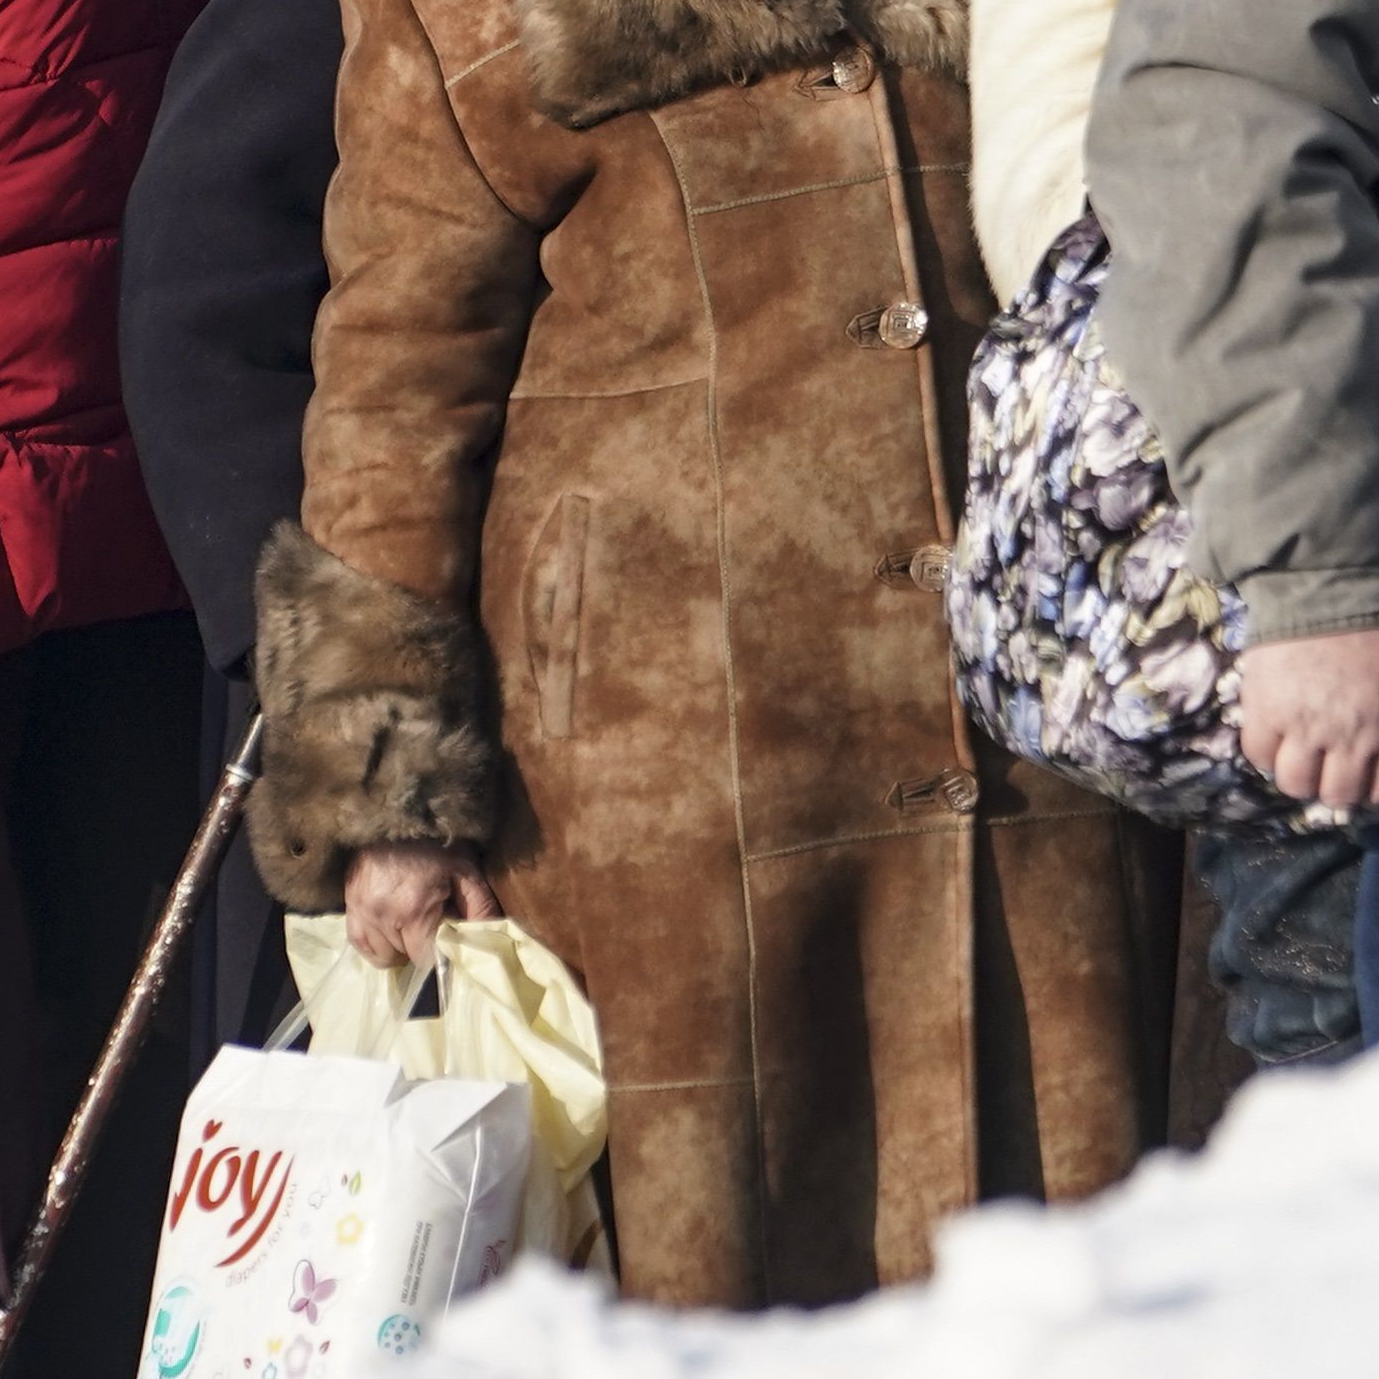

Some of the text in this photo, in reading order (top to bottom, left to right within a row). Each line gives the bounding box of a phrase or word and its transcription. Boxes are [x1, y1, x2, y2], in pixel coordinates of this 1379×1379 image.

[169, 1118, 283, 1239] joy
[267, 1223, 284, 1249] for
[281, 1183, 298, 1219] you
